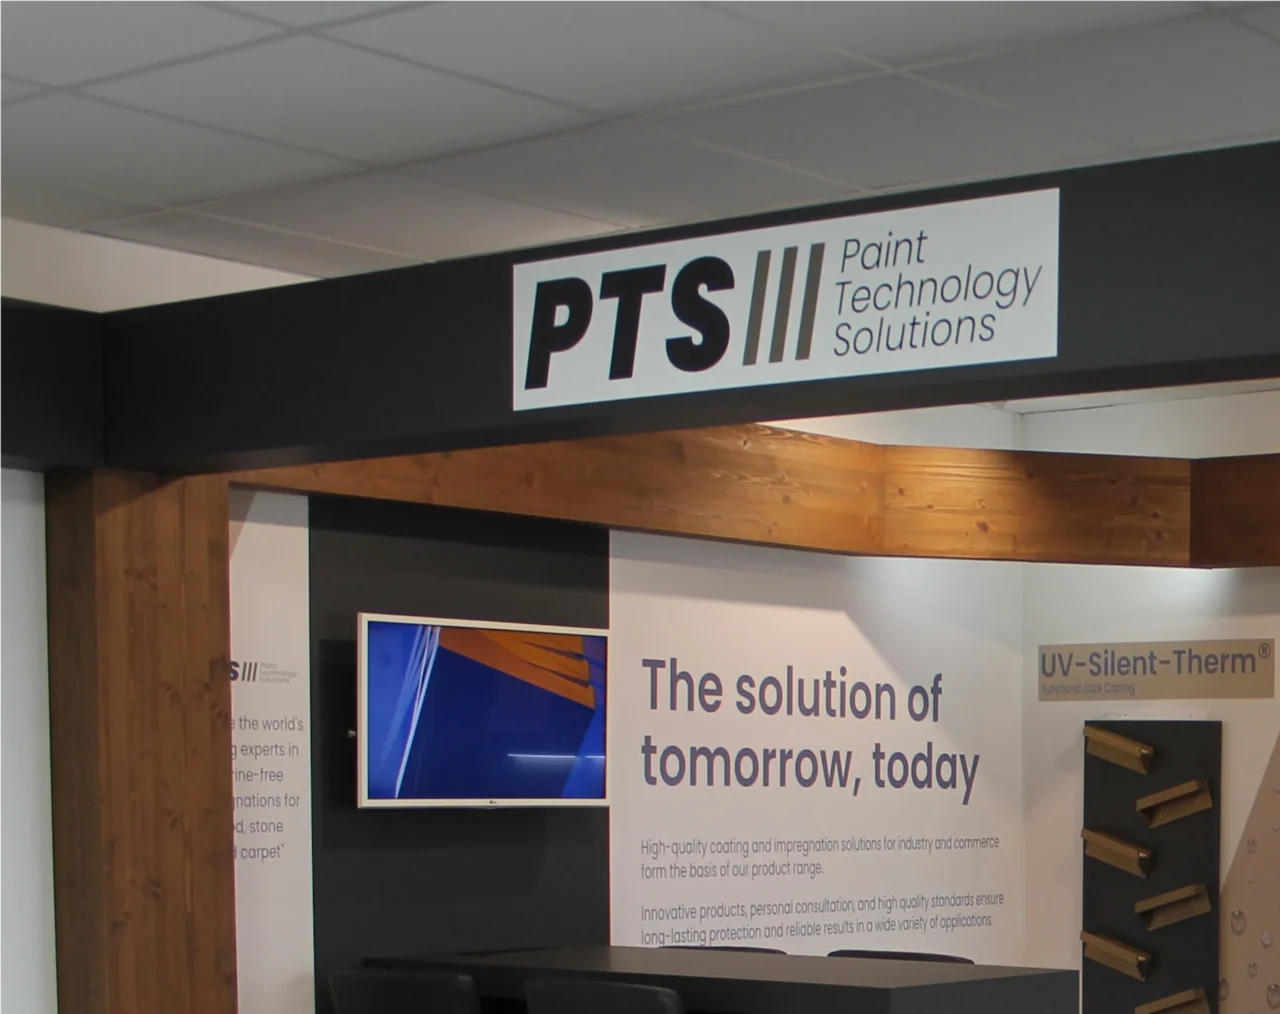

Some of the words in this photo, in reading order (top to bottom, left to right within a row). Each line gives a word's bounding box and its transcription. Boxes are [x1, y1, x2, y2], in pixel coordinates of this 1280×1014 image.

[841, 230, 928, 273] Paint
[836, 264, 1043, 315] Technology
[524, 255, 735, 390] PTS
[834, 313, 996, 357] Solutions
[642, 658, 723, 713] The
[736, 665, 896, 721] solution
[907, 672, 943, 722] of
[1104, 682, 1135, 696] Coating
[239, 716, 259, 731] the
[262, 716, 304, 731] world's
[240, 743, 285, 760] experts
[288, 742, 299, 756] in
[641, 735, 861, 797] tomorrow,
[872, 741, 980, 806] today
[234, 793, 281, 808] nations
[284, 792, 300, 807] for
[249, 820, 284, 833] stone
[641, 839, 708, 860] High-quality
[710, 838, 749, 858] coating
[752, 838, 772, 853] and
[774, 836, 839, 857] impregnation
[841, 836, 882, 851] solutions
[883, 835, 896, 850] for
[897, 836, 933, 854] industry
[934, 836, 952, 850] and
[954, 836, 1000, 849] commerce
[641, 863, 667, 879] form
[669, 863, 687, 879] the
[689, 862, 717, 878] basis
[719, 861, 730, 877] of
[732, 865, 749, 877] our
[751, 861, 791, 881] product
[793, 862, 824, 880] range.
[641, 903, 697, 921] Innovative
[699, 902, 748, 923] products,
[750, 899, 793, 921] personal
[795, 897, 856, 914] consultation,
[858, 896, 876, 911] and
[878, 895, 898, 914] high
[900, 893, 929, 912] quality
[931, 892, 974, 908] standards
[976, 893, 1004, 906] ensure
[641, 927, 707, 946] long-lasting
[709, 924, 761, 946] protection
[764, 923, 784, 939] and
[786, 921, 821, 937] reliable
[823, 919, 854, 935] results
[856, 917, 865, 933] in
[866, 921, 873, 933] a
[874, 916, 897, 932] wide
[898, 915, 928, 934] variety
[929, 914, 939, 929] of
[939, 912, 994, 933] applications.
